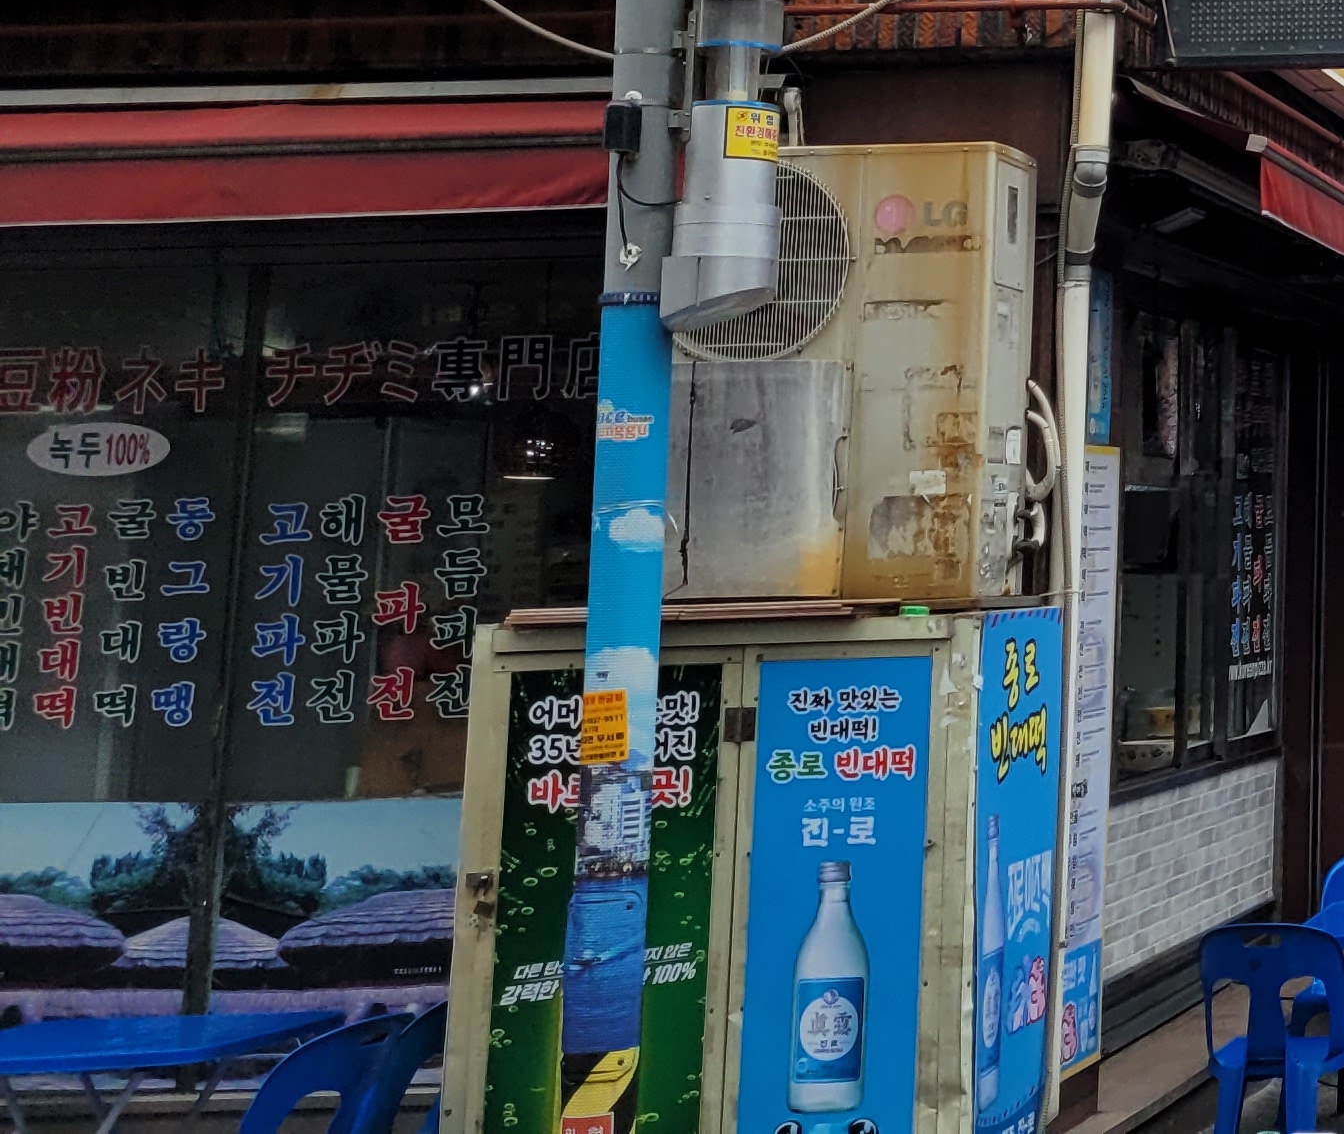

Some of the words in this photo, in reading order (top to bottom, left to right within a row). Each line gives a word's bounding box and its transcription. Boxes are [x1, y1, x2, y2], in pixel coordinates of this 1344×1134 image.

[924, 201, 968, 227] LG
[50, 432, 101, 468] 녹두
[106, 433, 150, 465] 100%
[151, 496, 215, 727] 동그랑땡
[246, 502, 311, 726] 고기파전
[306, 493, 368, 722] 해물파전
[367, 494, 431, 720] 굴파전
[1002, 637, 1038, 711] 종로
[789, 688, 832, 712] 진짜
[838, 686, 900, 711] 맛있는
[809, 717, 878, 741] 빈대떡!
[990, 706, 1048, 783] 빈대떡
[767, 750, 828, 783] 종로
[835, 745, 916, 780] 빈대떡
[803, 798, 845, 812] 소주의
[849, 797, 876, 811] 원조
[500, 980, 560, 1006] 강력한
[652, 961, 697, 984] 100%
